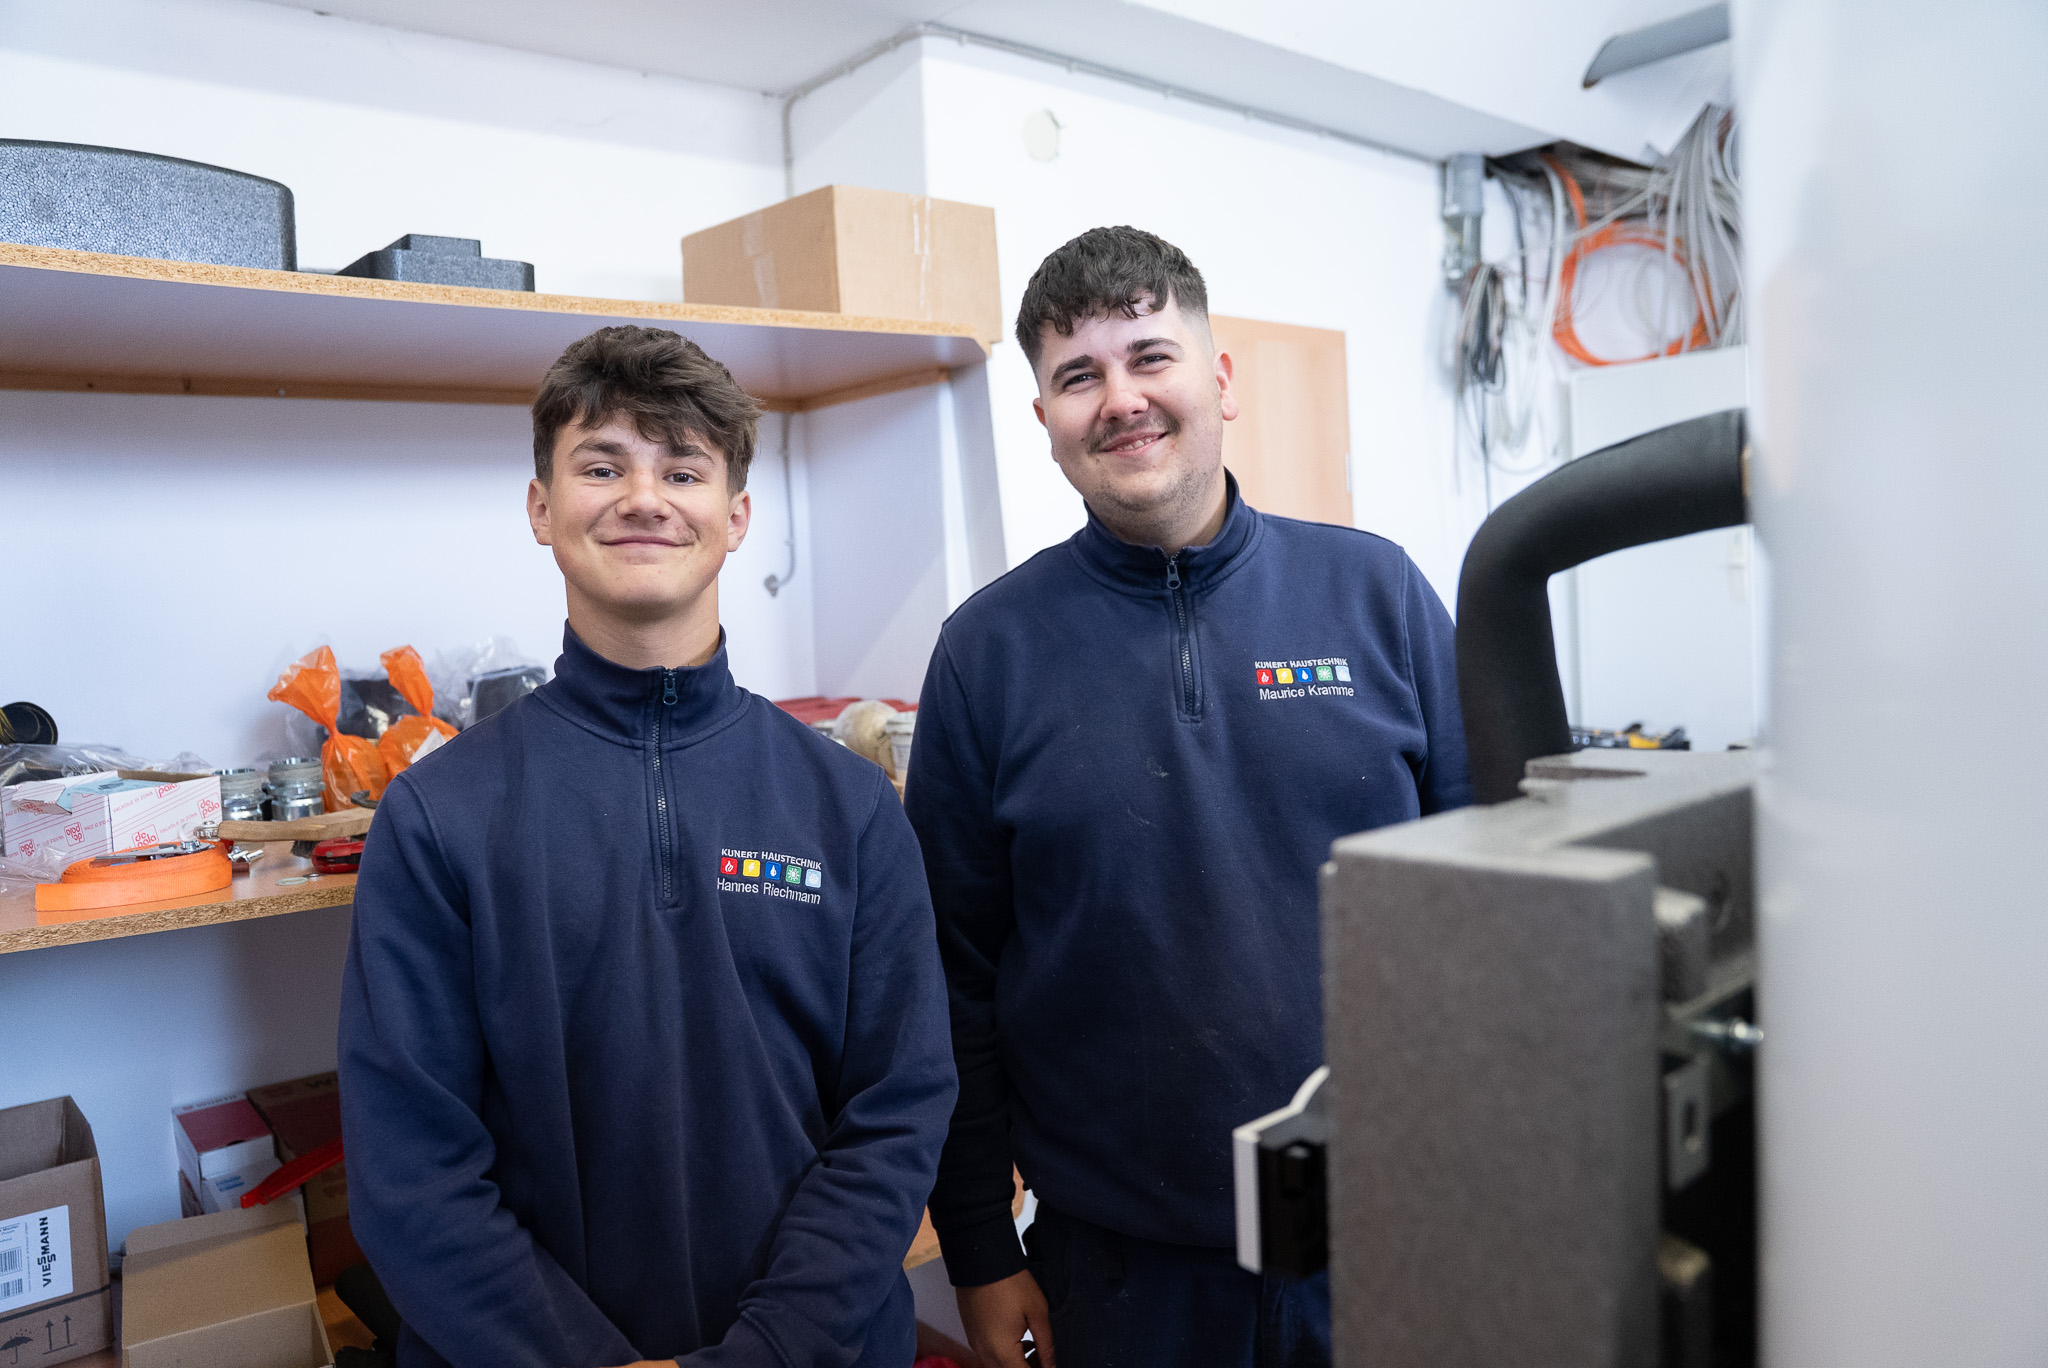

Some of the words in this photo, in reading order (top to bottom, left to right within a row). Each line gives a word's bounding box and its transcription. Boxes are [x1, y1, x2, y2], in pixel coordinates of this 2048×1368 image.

[1290, 657, 1348, 668] HAUSTECHNIK
[1260, 686, 1305, 700] Maurice
[1308, 684, 1354, 696] Kramme
[202, 801, 220, 818] pala
[721, 848, 758, 859] KUNERT
[762, 851, 822, 870] HAUSTECHNIK
[717, 877, 759, 893] Hannes
[763, 882, 821, 904] Riechmann
[37, 1216, 56, 1288] VIESSMANN
